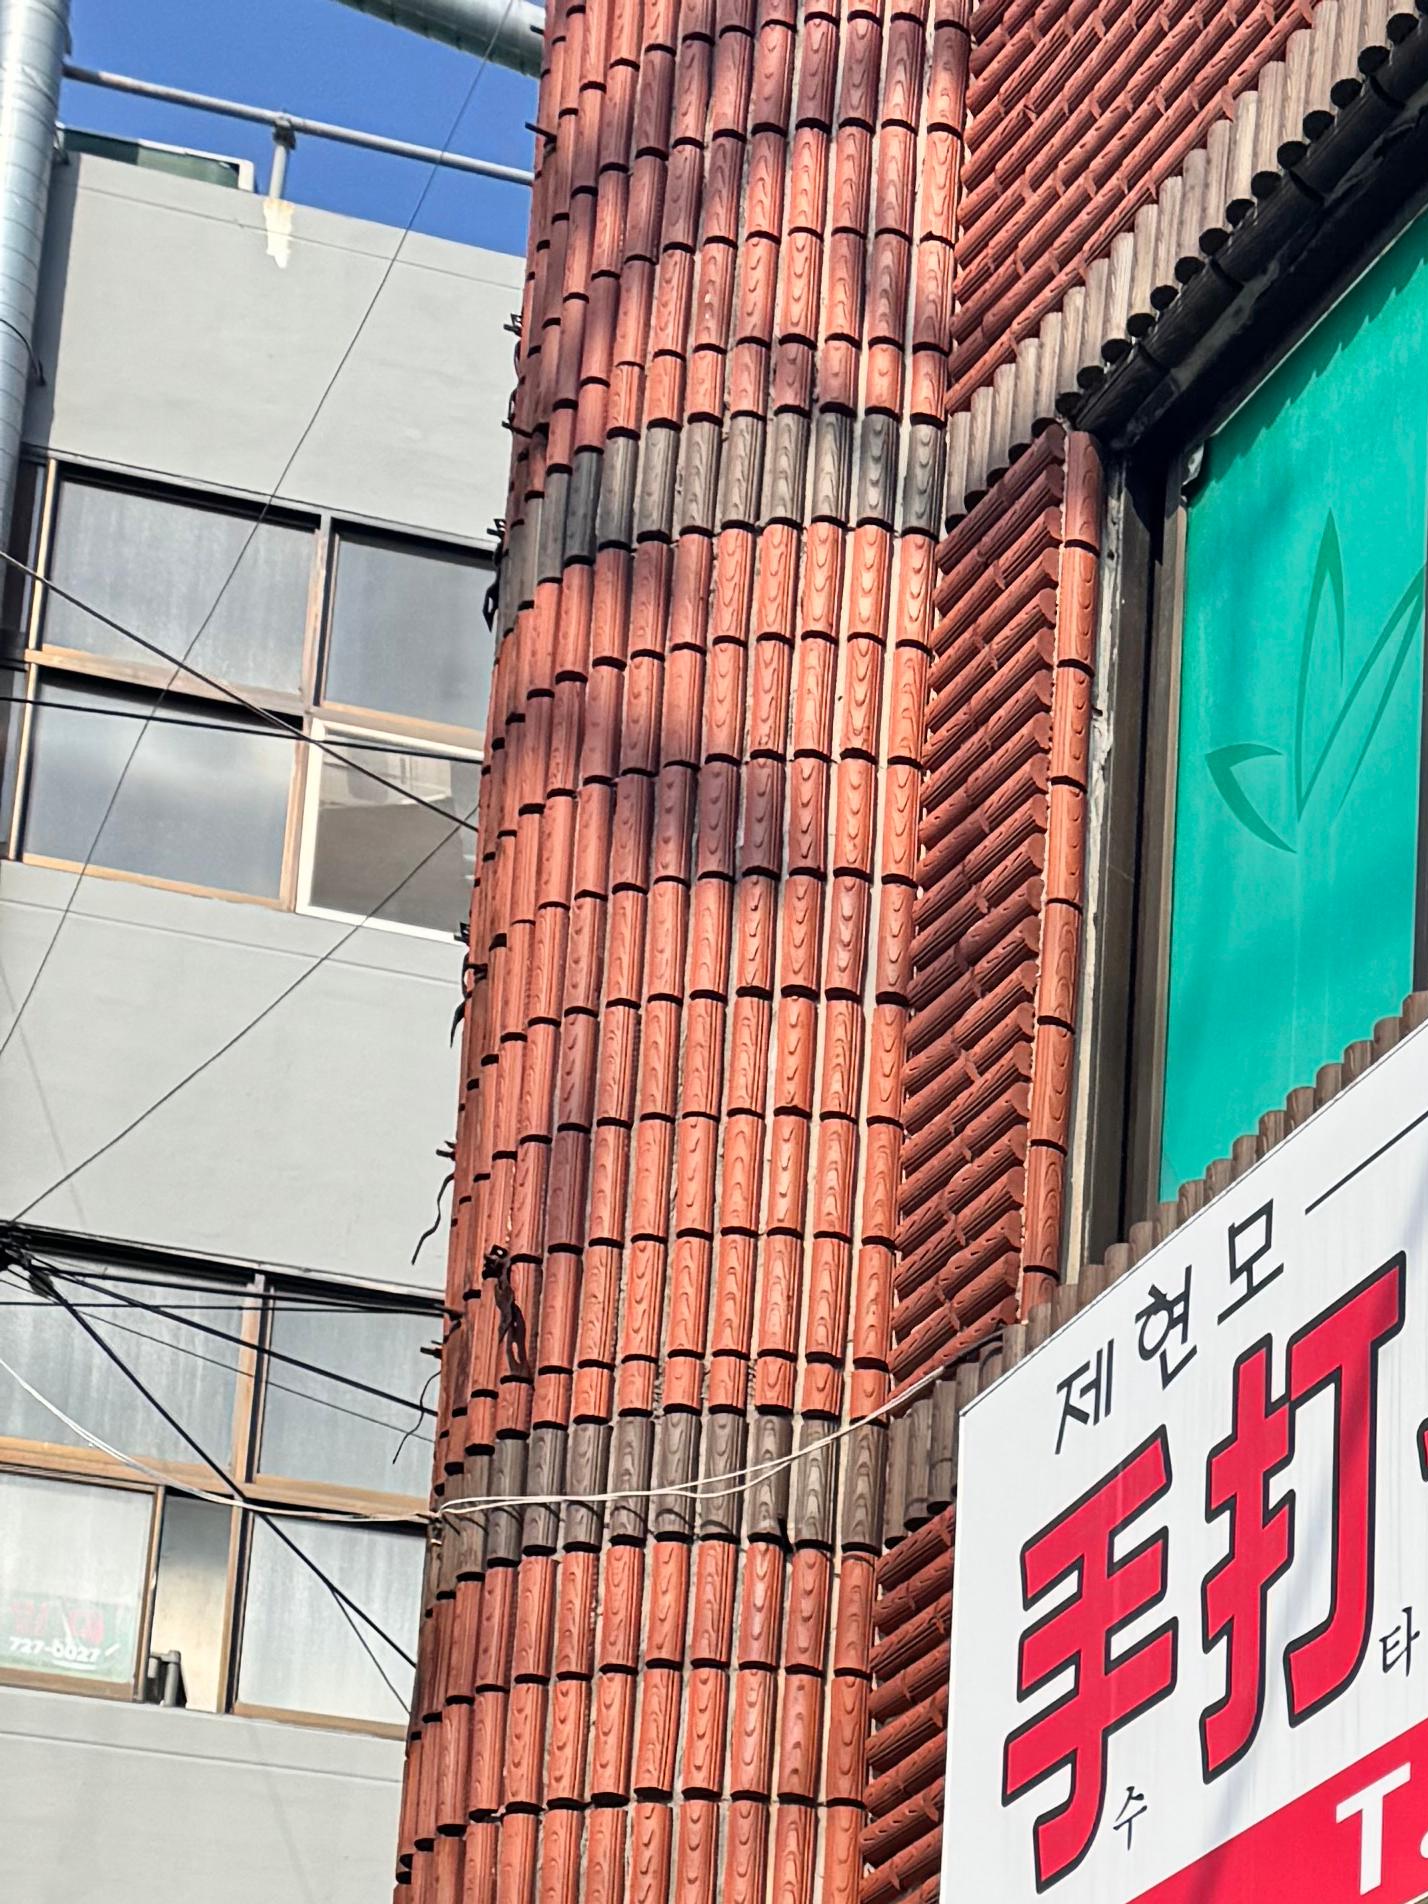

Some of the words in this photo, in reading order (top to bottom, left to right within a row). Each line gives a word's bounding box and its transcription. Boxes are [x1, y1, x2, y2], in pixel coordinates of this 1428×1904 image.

[1053, 1197, 1284, 1454] 제현모
[1378, 1607, 1420, 1676] 타
[1112, 1784, 1148, 1852] 수
